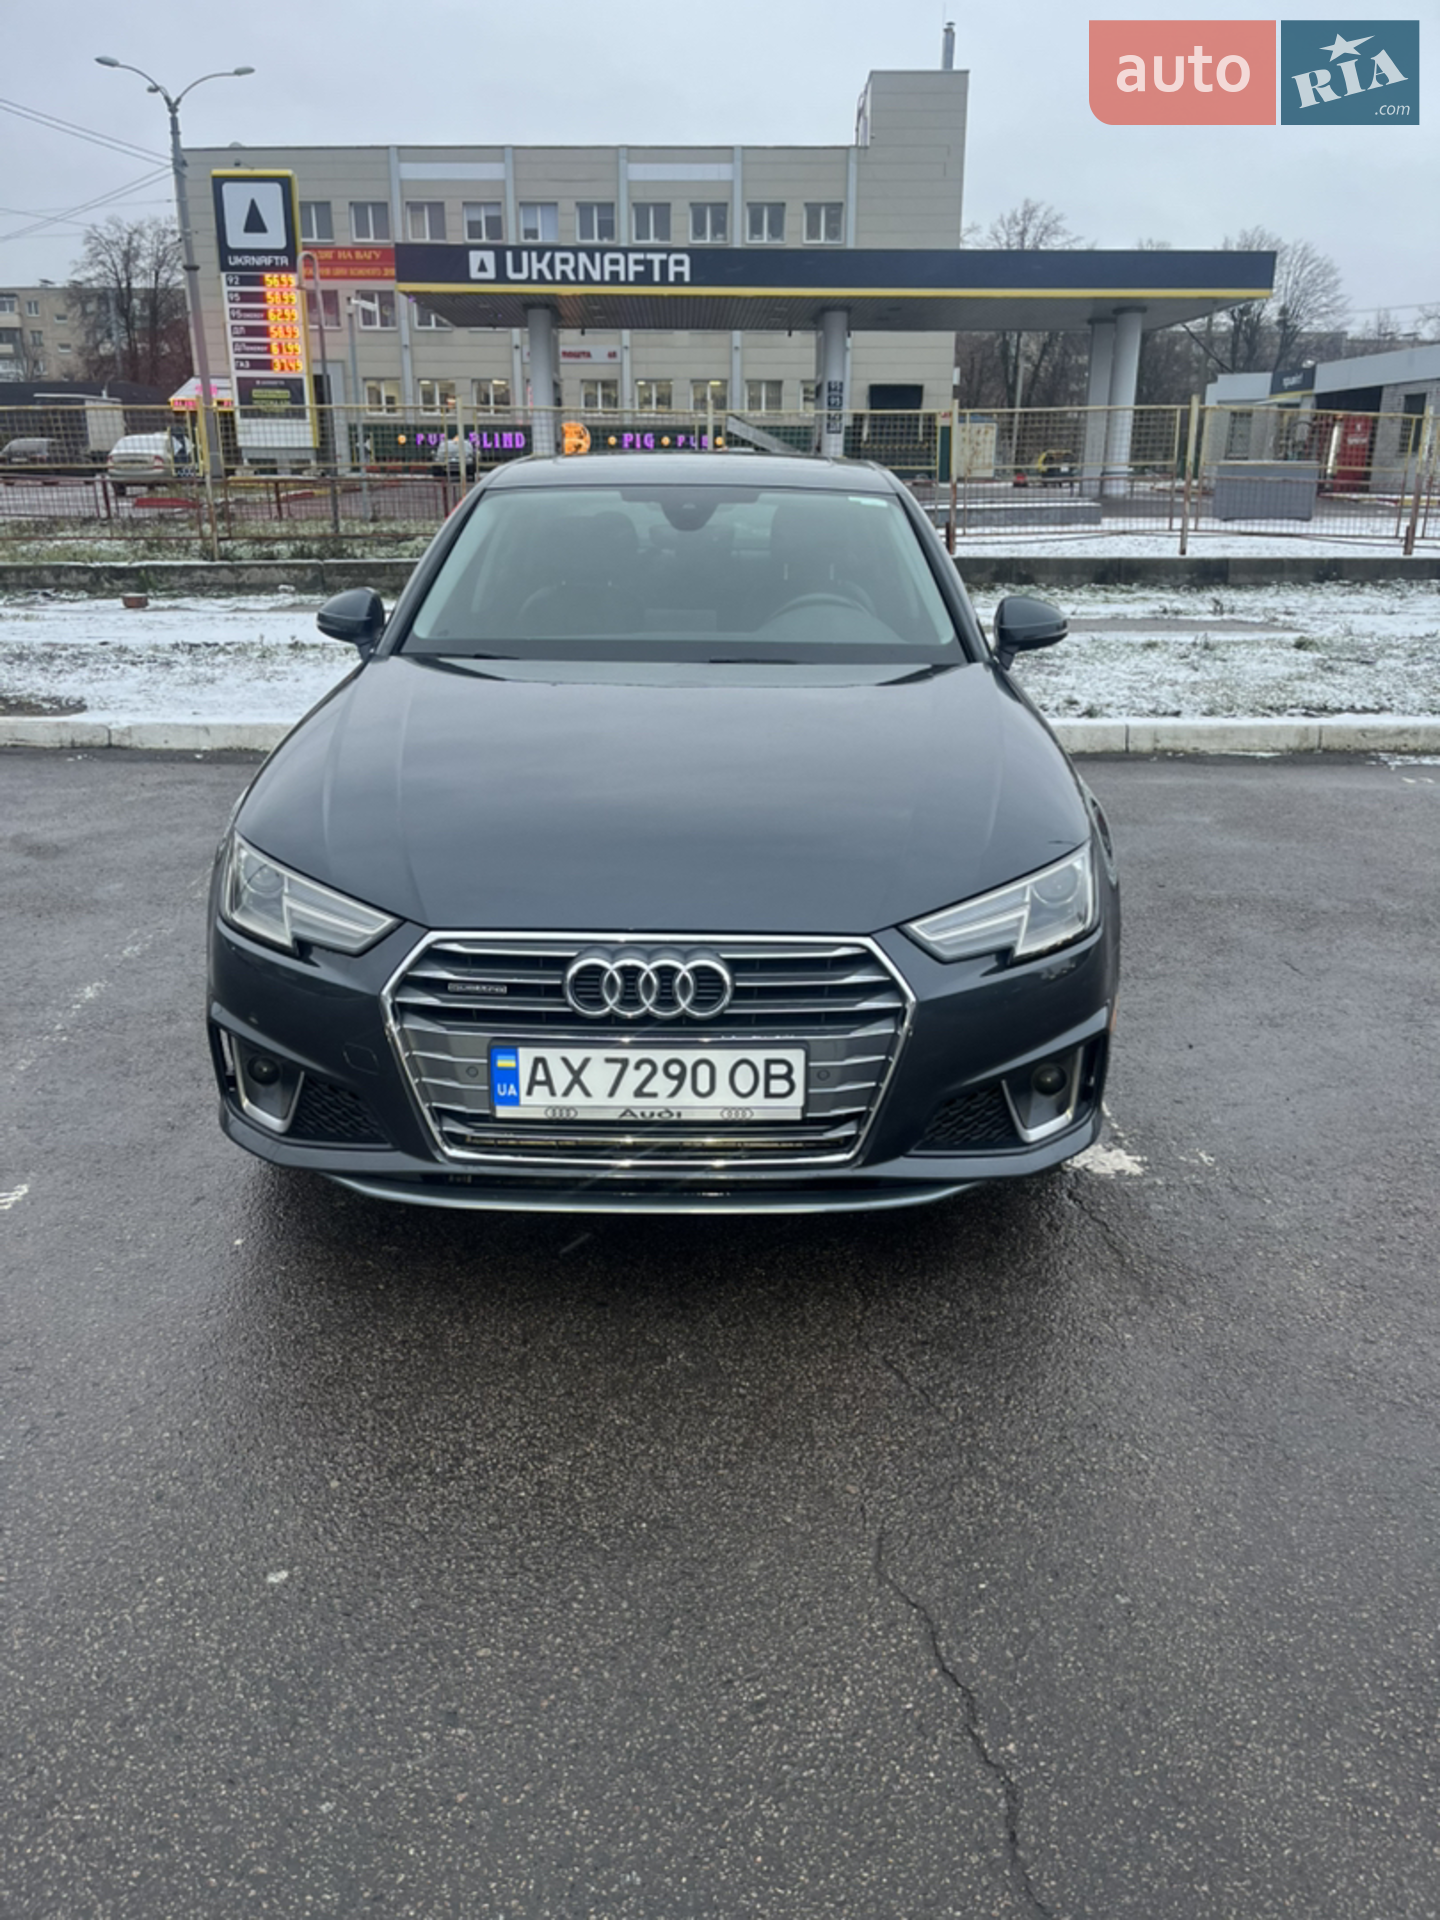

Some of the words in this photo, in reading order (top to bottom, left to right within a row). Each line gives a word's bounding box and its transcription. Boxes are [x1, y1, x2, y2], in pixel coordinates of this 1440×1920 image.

[228, 255, 289, 266] UKRNAFTA
[506, 250, 690, 282] UKRNAFTA
[227, 274, 240, 285] 92
[228, 292, 241, 302] 95
[622, 433, 654, 448] PIG
[525, 1056, 592, 1098] AX
[604, 1057, 717, 1099] 7290
[728, 1058, 796, 1099] OB
[497, 1082, 517, 1097] UA
[618, 1108, 682, 1119] Audi
